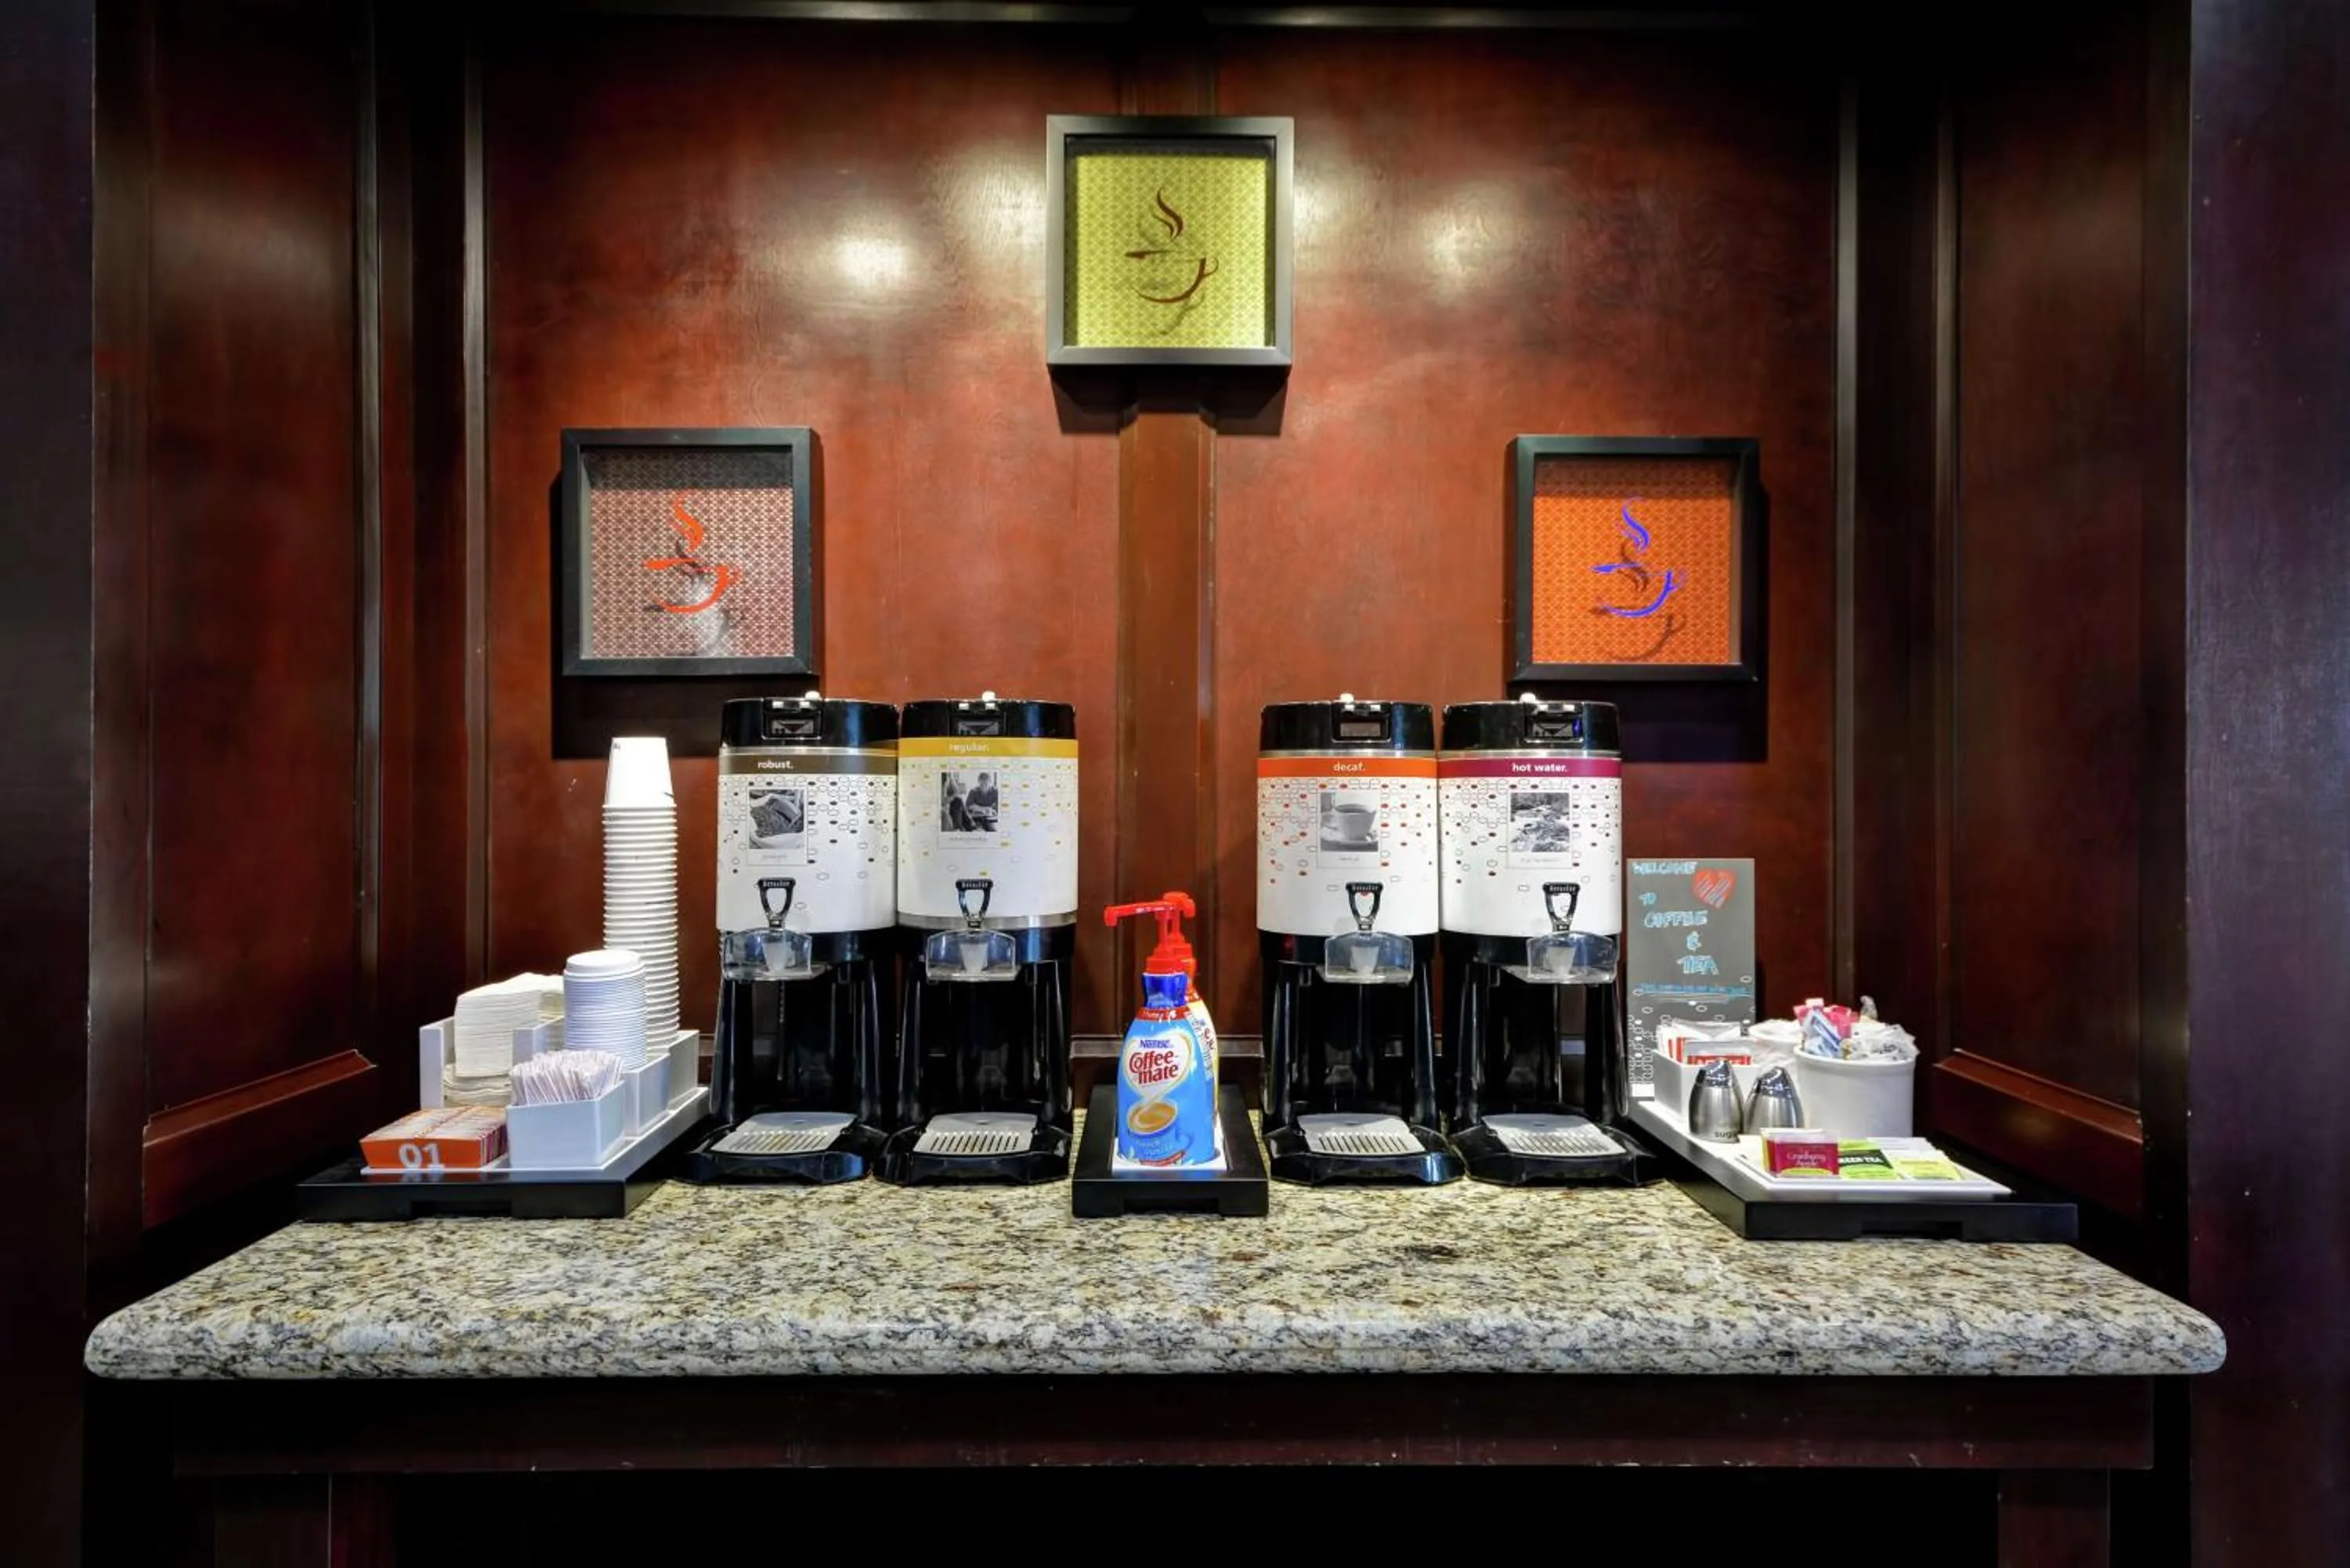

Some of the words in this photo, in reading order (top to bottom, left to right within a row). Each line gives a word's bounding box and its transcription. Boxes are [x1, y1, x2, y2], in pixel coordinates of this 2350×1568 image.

[757, 760, 794, 769] robust.
[1333, 761, 1365, 771] decaf.
[1512, 762, 1531, 771] hot
[1138, 1064, 1179, 1085] mate
[399, 1143, 446, 1169] 01
